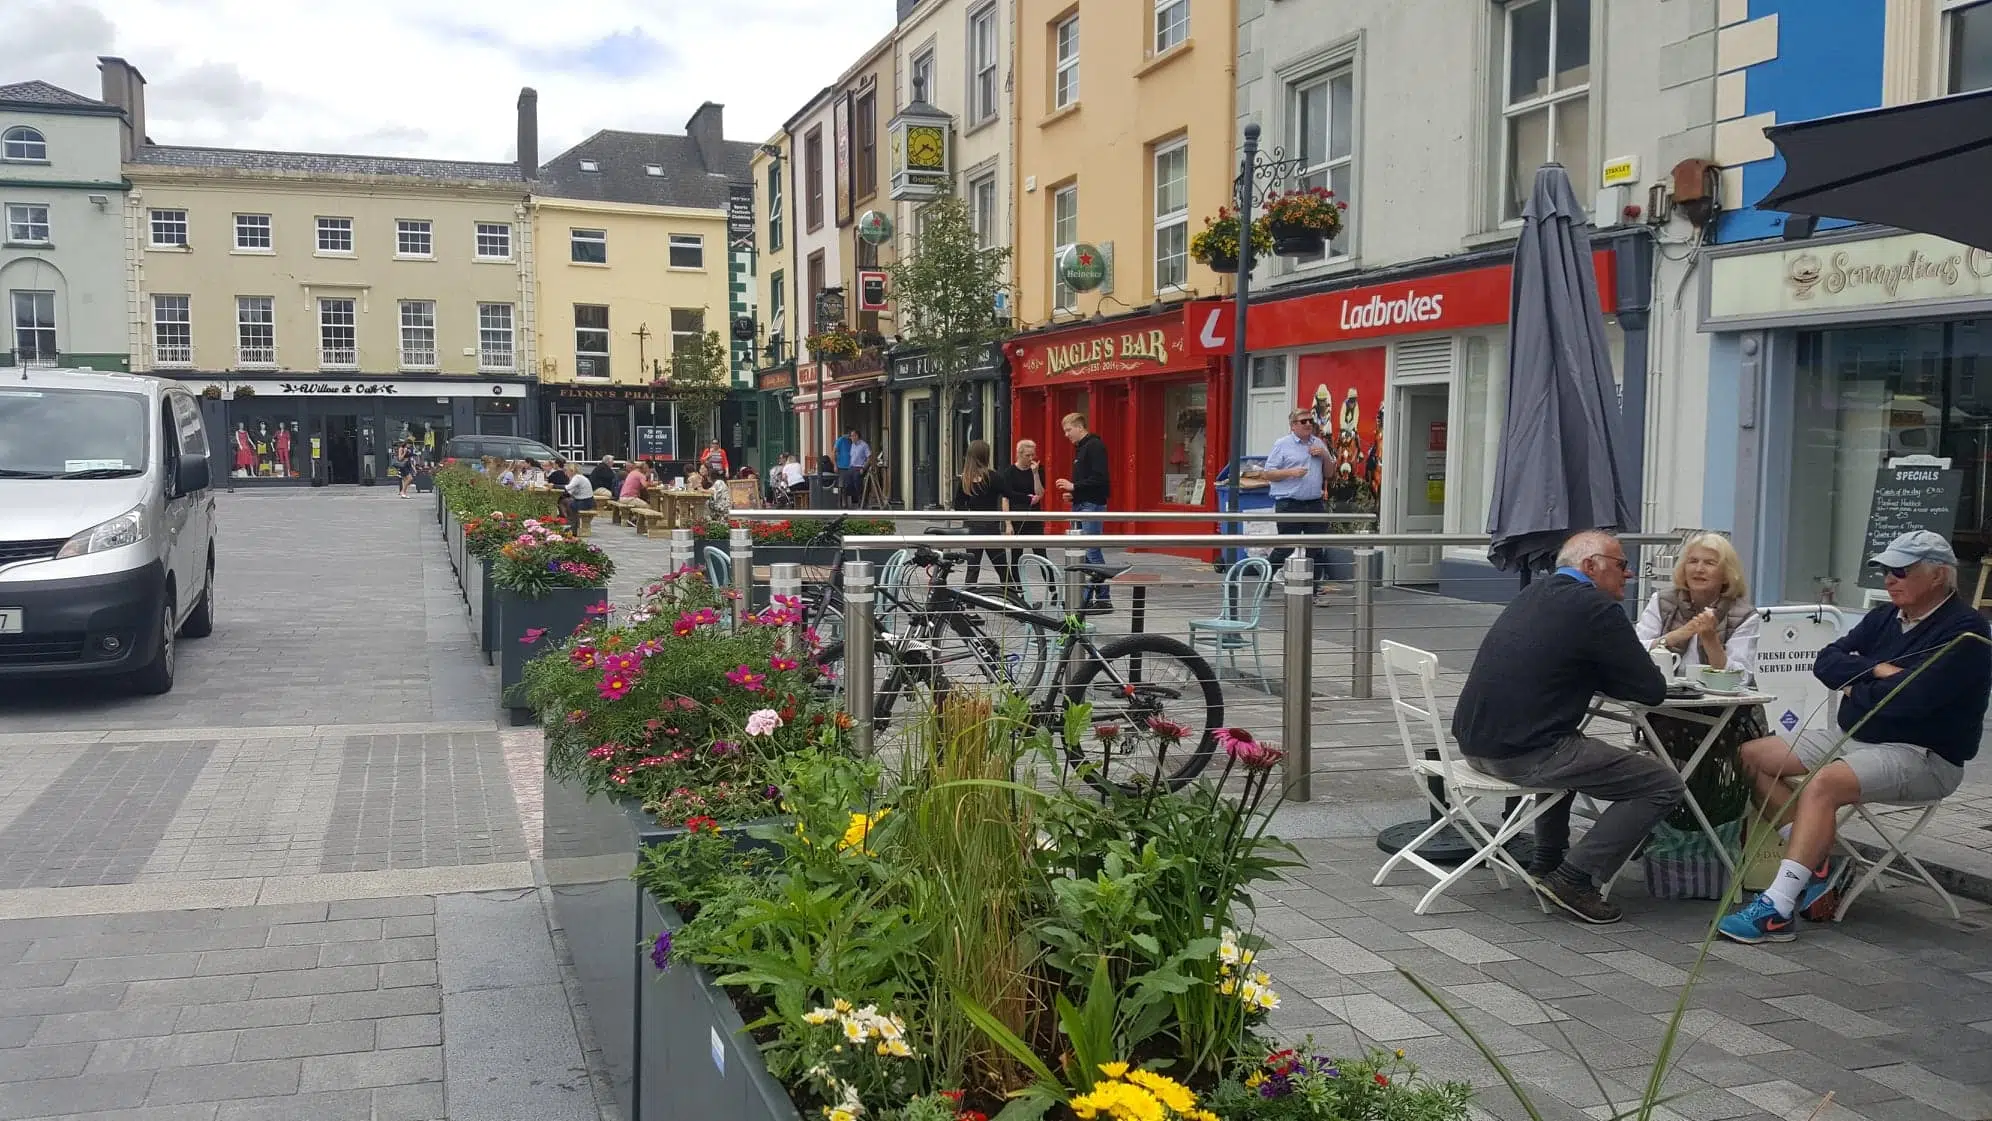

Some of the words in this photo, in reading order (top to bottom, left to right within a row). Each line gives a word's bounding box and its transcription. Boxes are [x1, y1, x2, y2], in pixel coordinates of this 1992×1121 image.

[1605, 163, 1631, 176] STANLEY
[1066, 269, 1102, 278] Heineken
[1826, 249, 1962, 297] Scrumptious
[1340, 289, 1444, 331] Ladbrokes
[1046, 335, 1115, 376] NAGLE'S
[1119, 328, 1168, 366] BAR
[300, 383, 340, 394] Willow
[341, 384, 352, 393] &
[355, 383, 379, 394] Oak
[560, 389, 617, 398] FLYNN'S
[1896, 470, 1939, 480] SPECIALS
[1757, 651, 1785, 660] FRESH
[1788, 651, 1817, 660] COFFE
[1759, 663, 1793, 673] SERVED
[1795, 663, 1814, 672] HER
